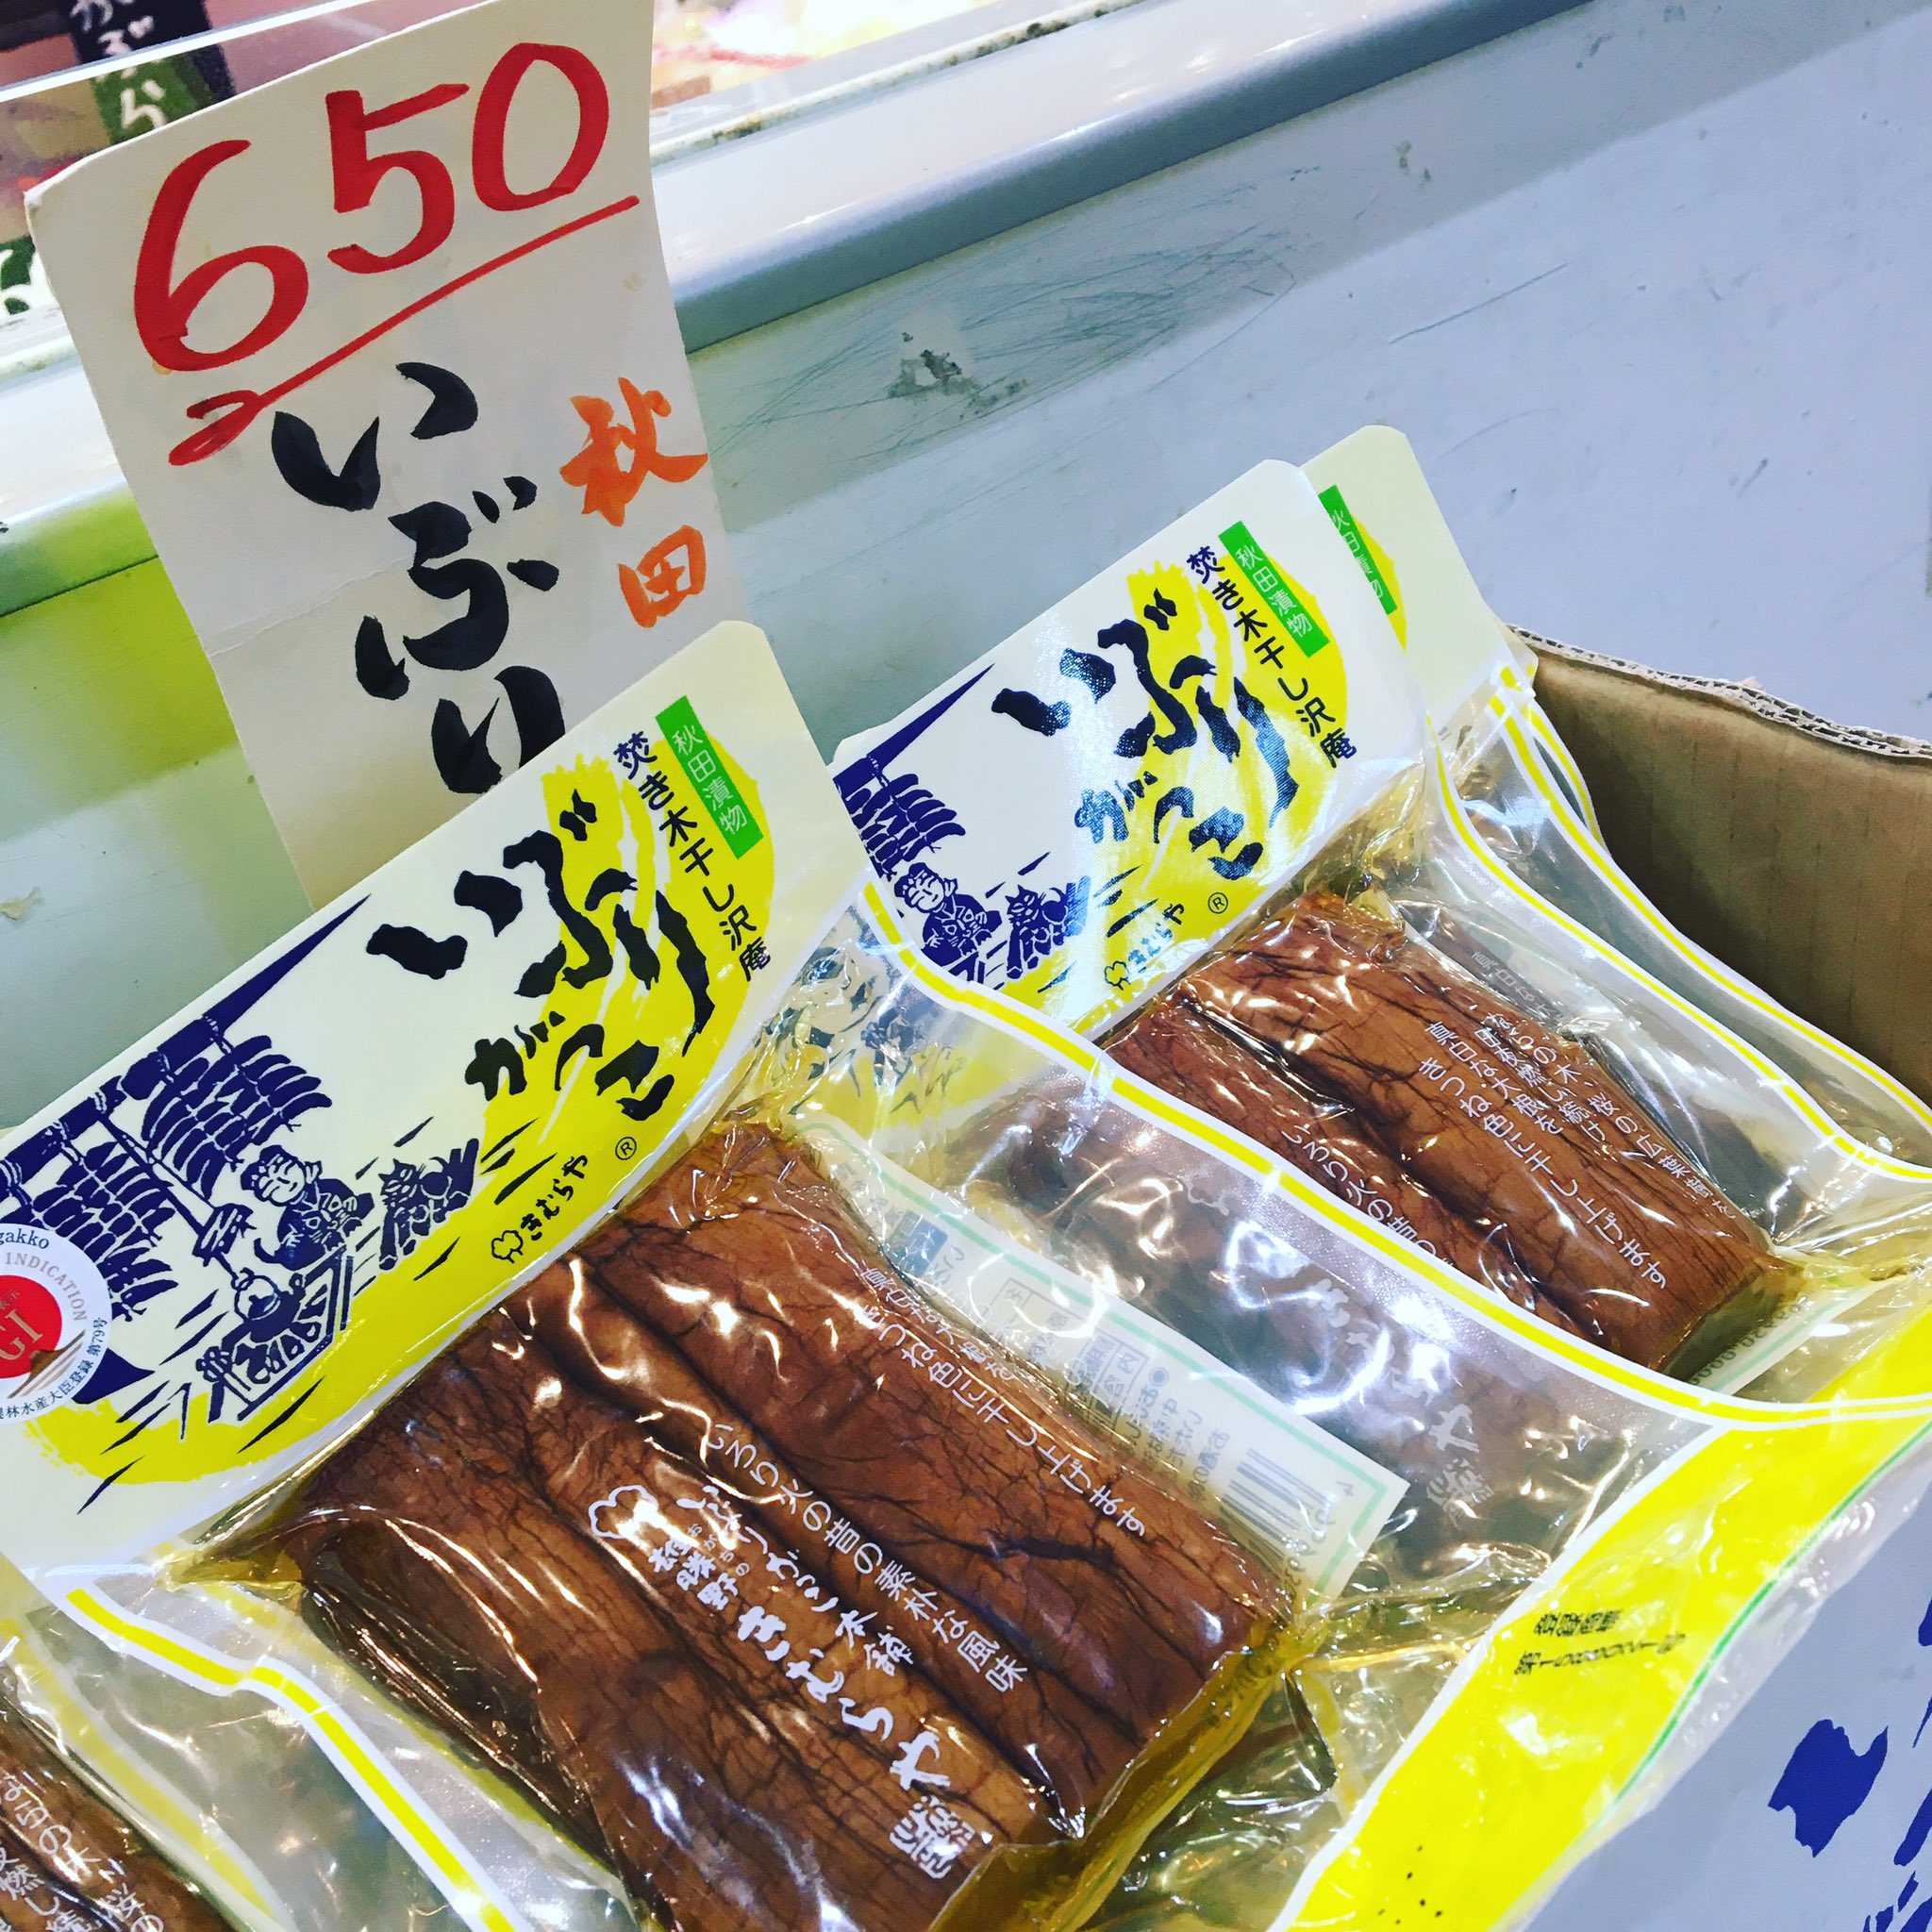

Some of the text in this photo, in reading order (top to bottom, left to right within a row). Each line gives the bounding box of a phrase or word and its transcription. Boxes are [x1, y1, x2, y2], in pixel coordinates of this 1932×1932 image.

[133, 42, 610, 373] 650
[558, 377, 708, 628] 秋田
[1236, 543, 1313, 638] 秋田漬物
[1186, 544, 1357, 768] 焚き木干し沢庵
[613, 730, 772, 982] 焚き木干し沢庵
[673, 724, 749, 835] 秋田漬物
[1281, 1124, 1454, 1267] いろり火の昔の
[1418, 1058, 1668, 1290] きつね色に干し上げます
[6, 1252, 88, 1321] INDICATION
